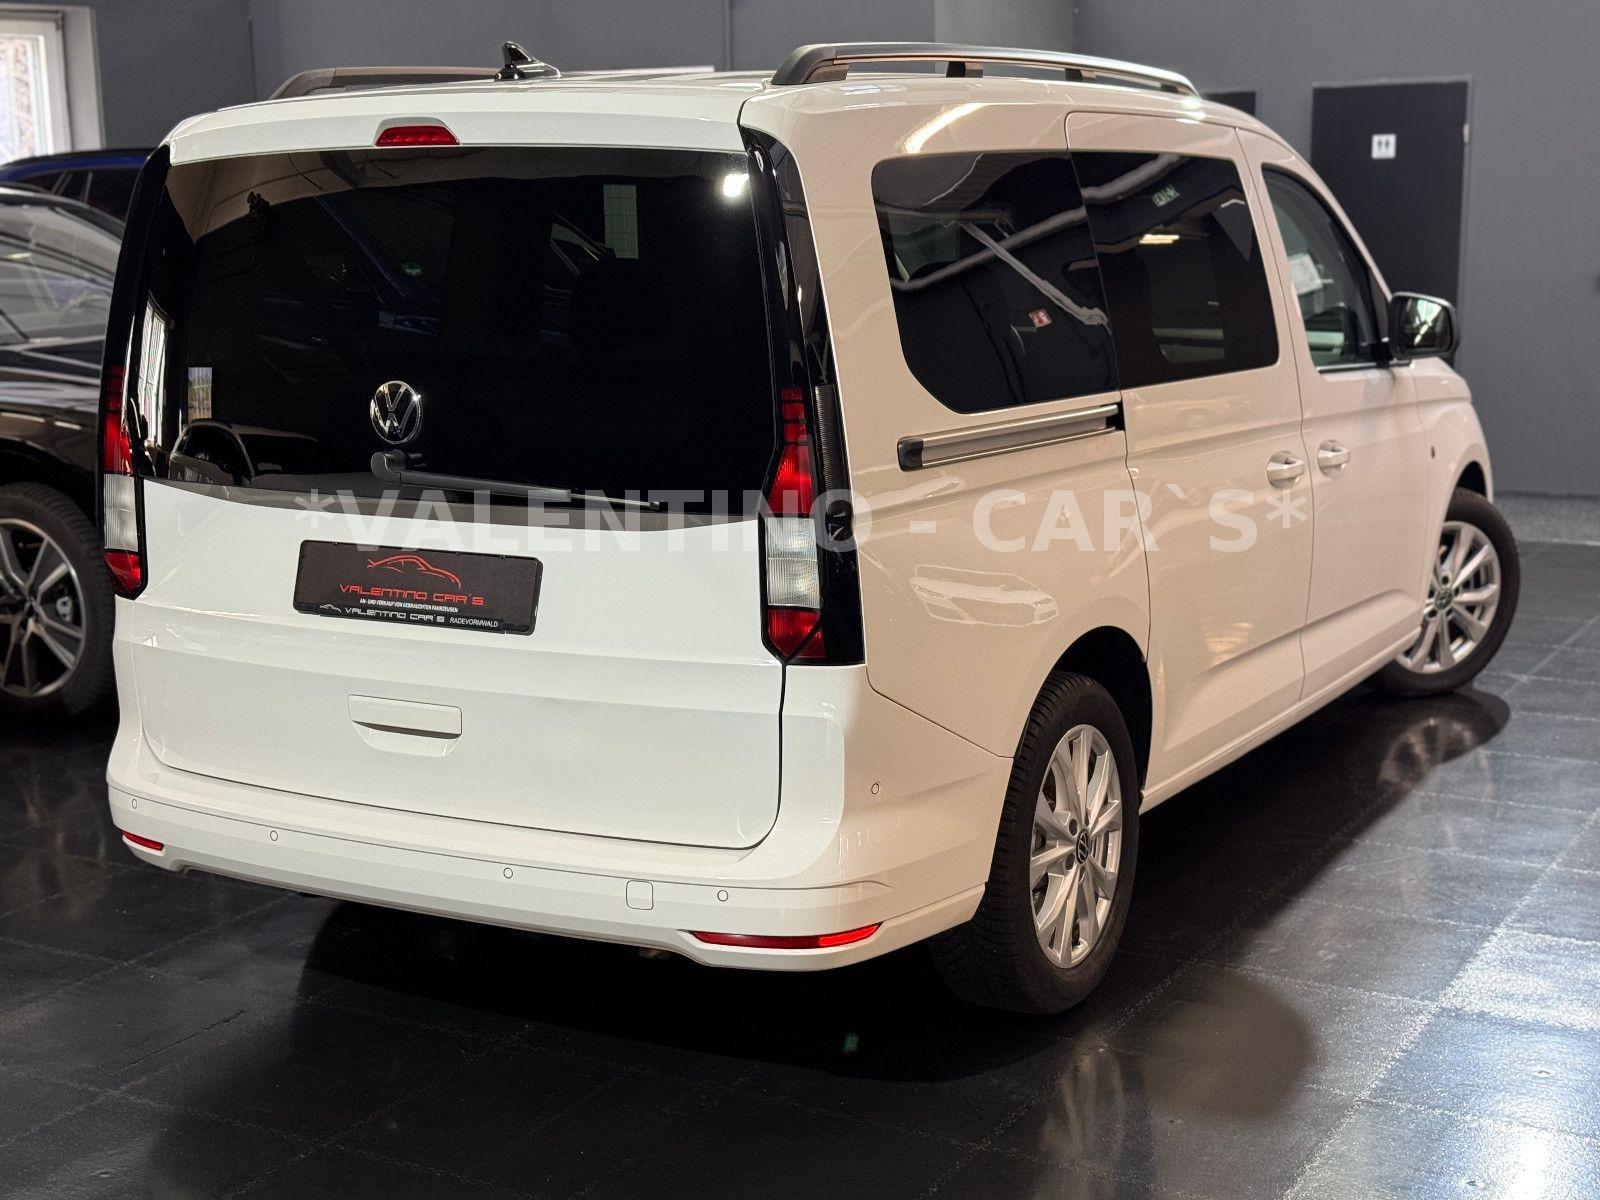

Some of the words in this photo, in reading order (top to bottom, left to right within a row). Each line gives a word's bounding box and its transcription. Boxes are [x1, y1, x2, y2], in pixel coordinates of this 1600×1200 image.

[370, 380, 421, 443] VW
[340, 584, 428, 601] VALENTINO
[345, 607, 407, 619] VALENTINO
[449, 617, 499, 628] RADEVORMWALD
